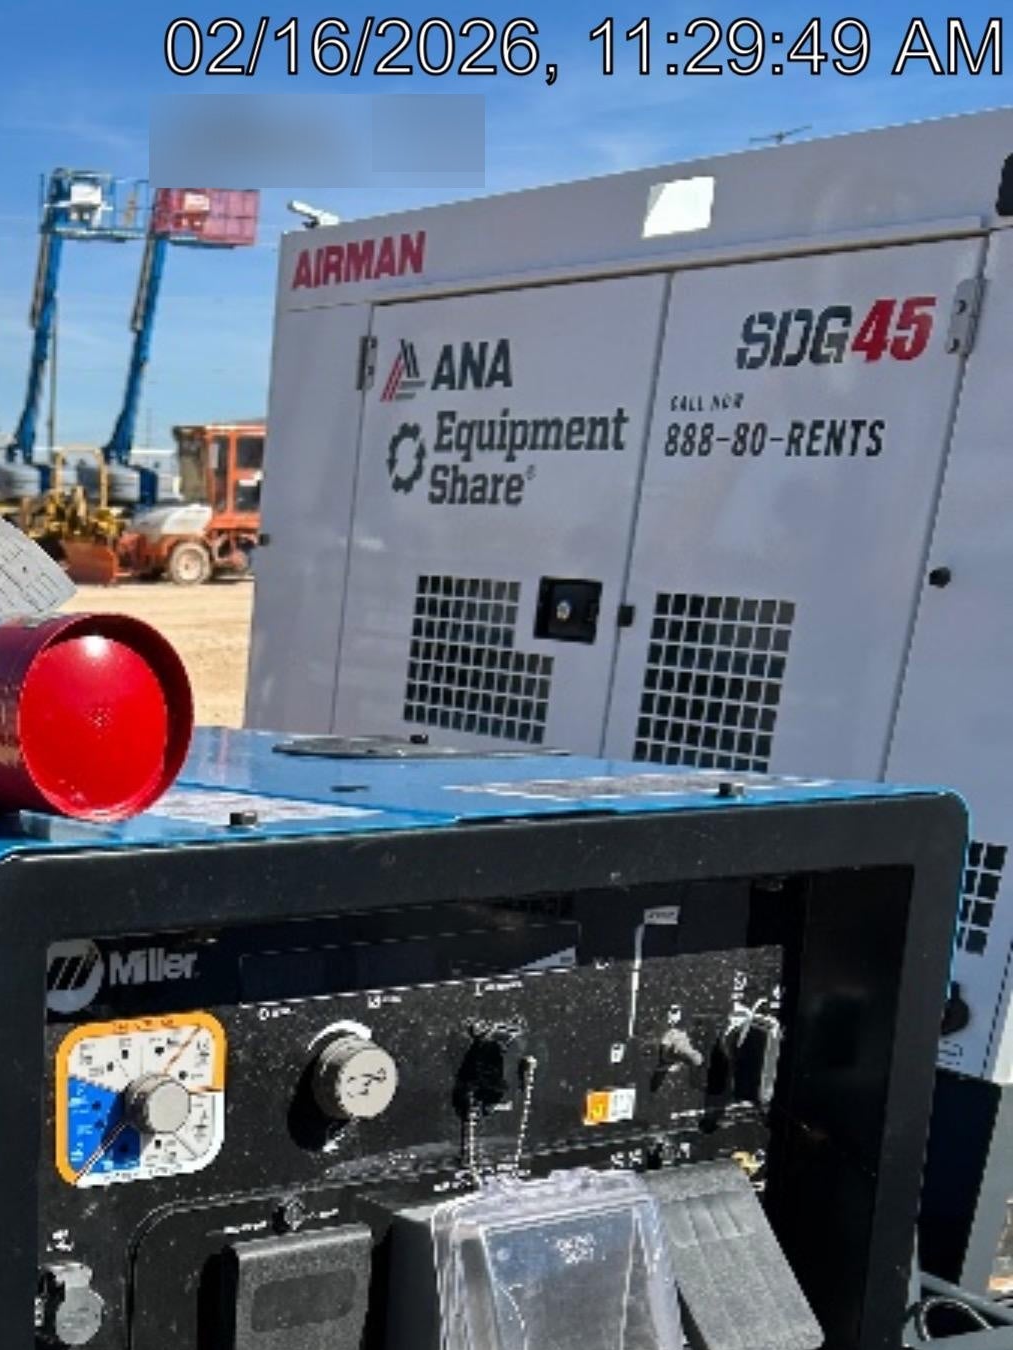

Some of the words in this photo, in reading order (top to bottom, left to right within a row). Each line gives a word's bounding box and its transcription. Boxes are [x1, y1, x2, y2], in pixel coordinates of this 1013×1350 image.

[291, 230, 426, 290] AIRMAN
[734, 297, 937, 369] SDG45
[430, 337, 513, 391] ANA
[432, 407, 630, 462] Equipment
[663, 418, 886, 457] 888-80-RENTS
[108, 947, 199, 986] Miller
